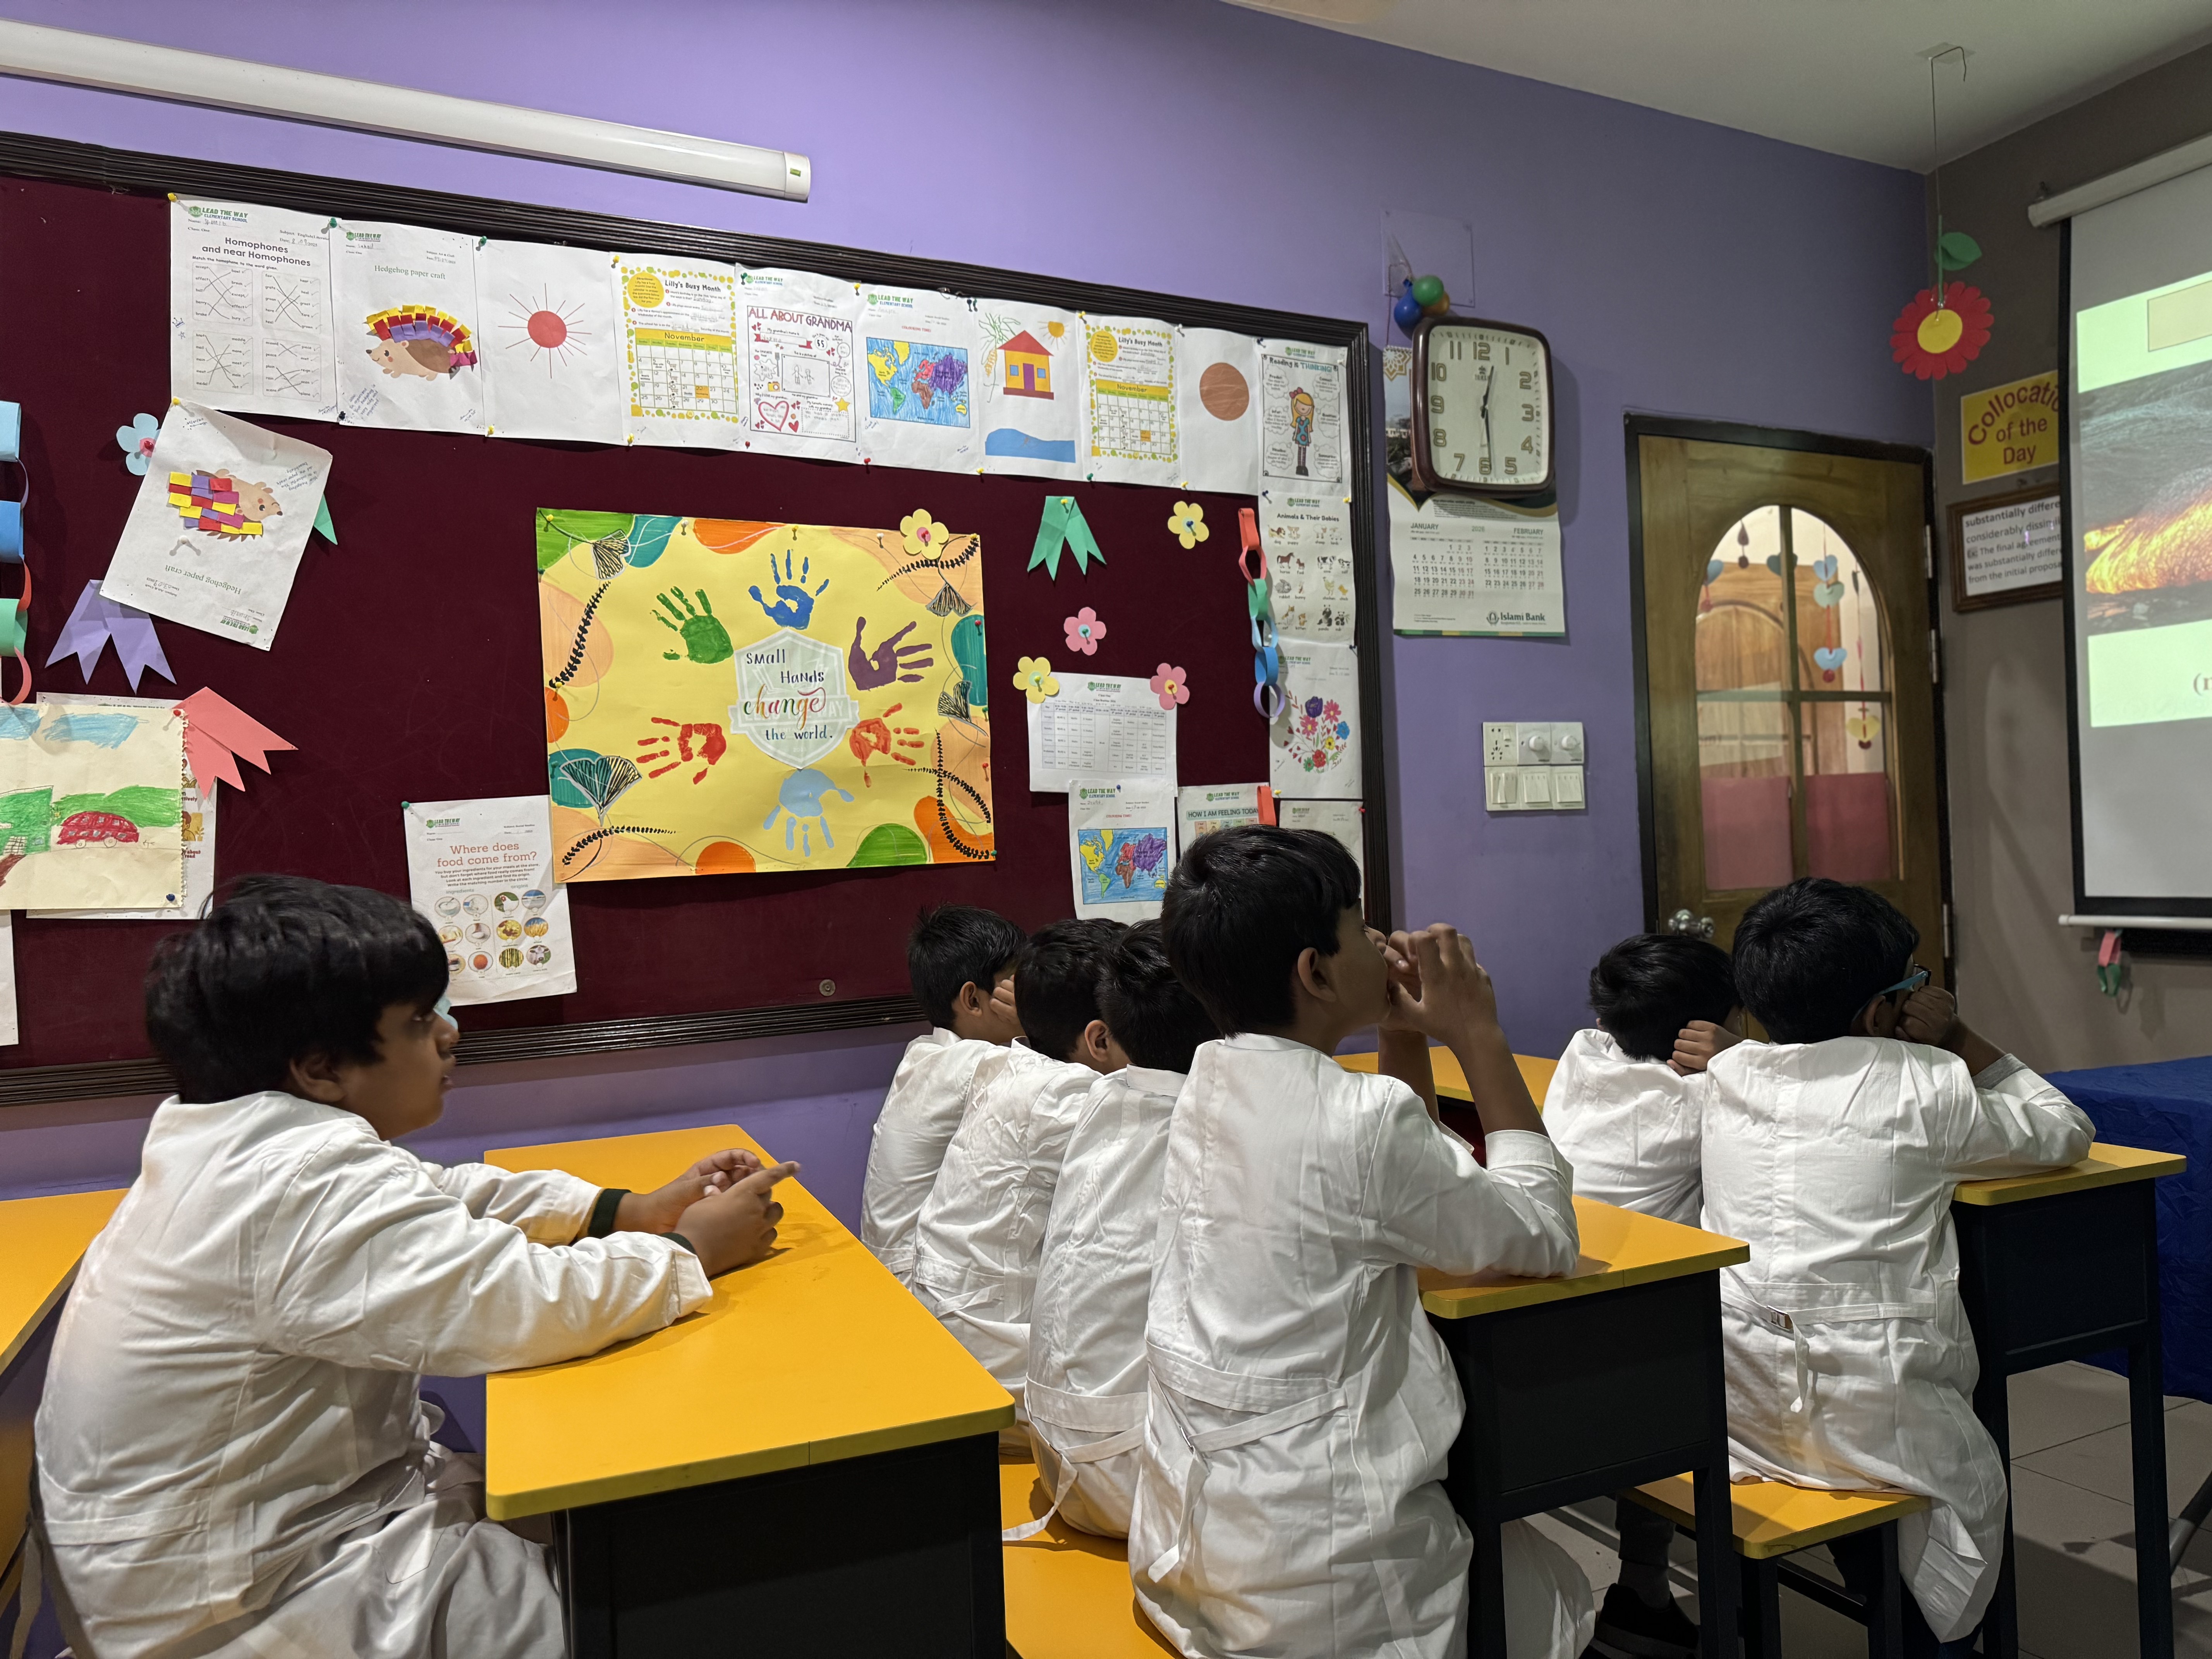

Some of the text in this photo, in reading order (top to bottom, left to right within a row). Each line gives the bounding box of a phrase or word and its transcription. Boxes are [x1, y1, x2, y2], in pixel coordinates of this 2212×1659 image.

[225, 237, 288, 253] Homophones
[224, 249, 246, 257] near
[248, 251, 311, 266] Homophones
[374, 265, 409, 275] Hedgehog
[665, 280, 683, 289] Lilly's
[749, 307, 852, 333] ALL ABOUT GRANDMA
[665, 332, 704, 342] November
[817, 339, 824, 347] 55
[1449, 340, 1462, 360] 11
[1473, 342, 1490, 361] 12
[1506, 347, 1509, 365] 1
[1269, 357, 1293, 368] Reading
[1300, 362, 1332, 372] THINKING!
[1431, 362, 1447, 381] 10
[1117, 384, 1147, 392] November
[1519, 371, 1532, 390] 2
[1431, 395, 1444, 414] 9
[1522, 404, 1534, 422] 3
[1433, 428, 1447, 447] 8
[1996, 418, 2047, 442] of the
[1521, 436, 1533, 454] 4
[1453, 453, 1465, 471] 7
[2004, 445, 2036, 464] Day
[1479, 457, 1491, 475] 6
[1504, 457, 1517, 475] 5
[1965, 508, 2025, 527] substantially
[1966, 525, 2023, 543] considerably
[1967, 534, 2060, 559] Ex: The final agreement
[1985, 552, 2034, 567] substantially
[165, 565, 241, 594] Hedgehog paper craft
[1969, 574, 1987, 584] from
[2005, 567, 2027, 577] initial
[2029, 562, 2062, 574] proposa
[1501, 612, 1545, 621] Islami Bank
[744, 684, 826, 730] change
[766, 725, 833, 740] the world.
[450, 843, 519, 854] Where does
[437, 851, 537, 867] food come from?
